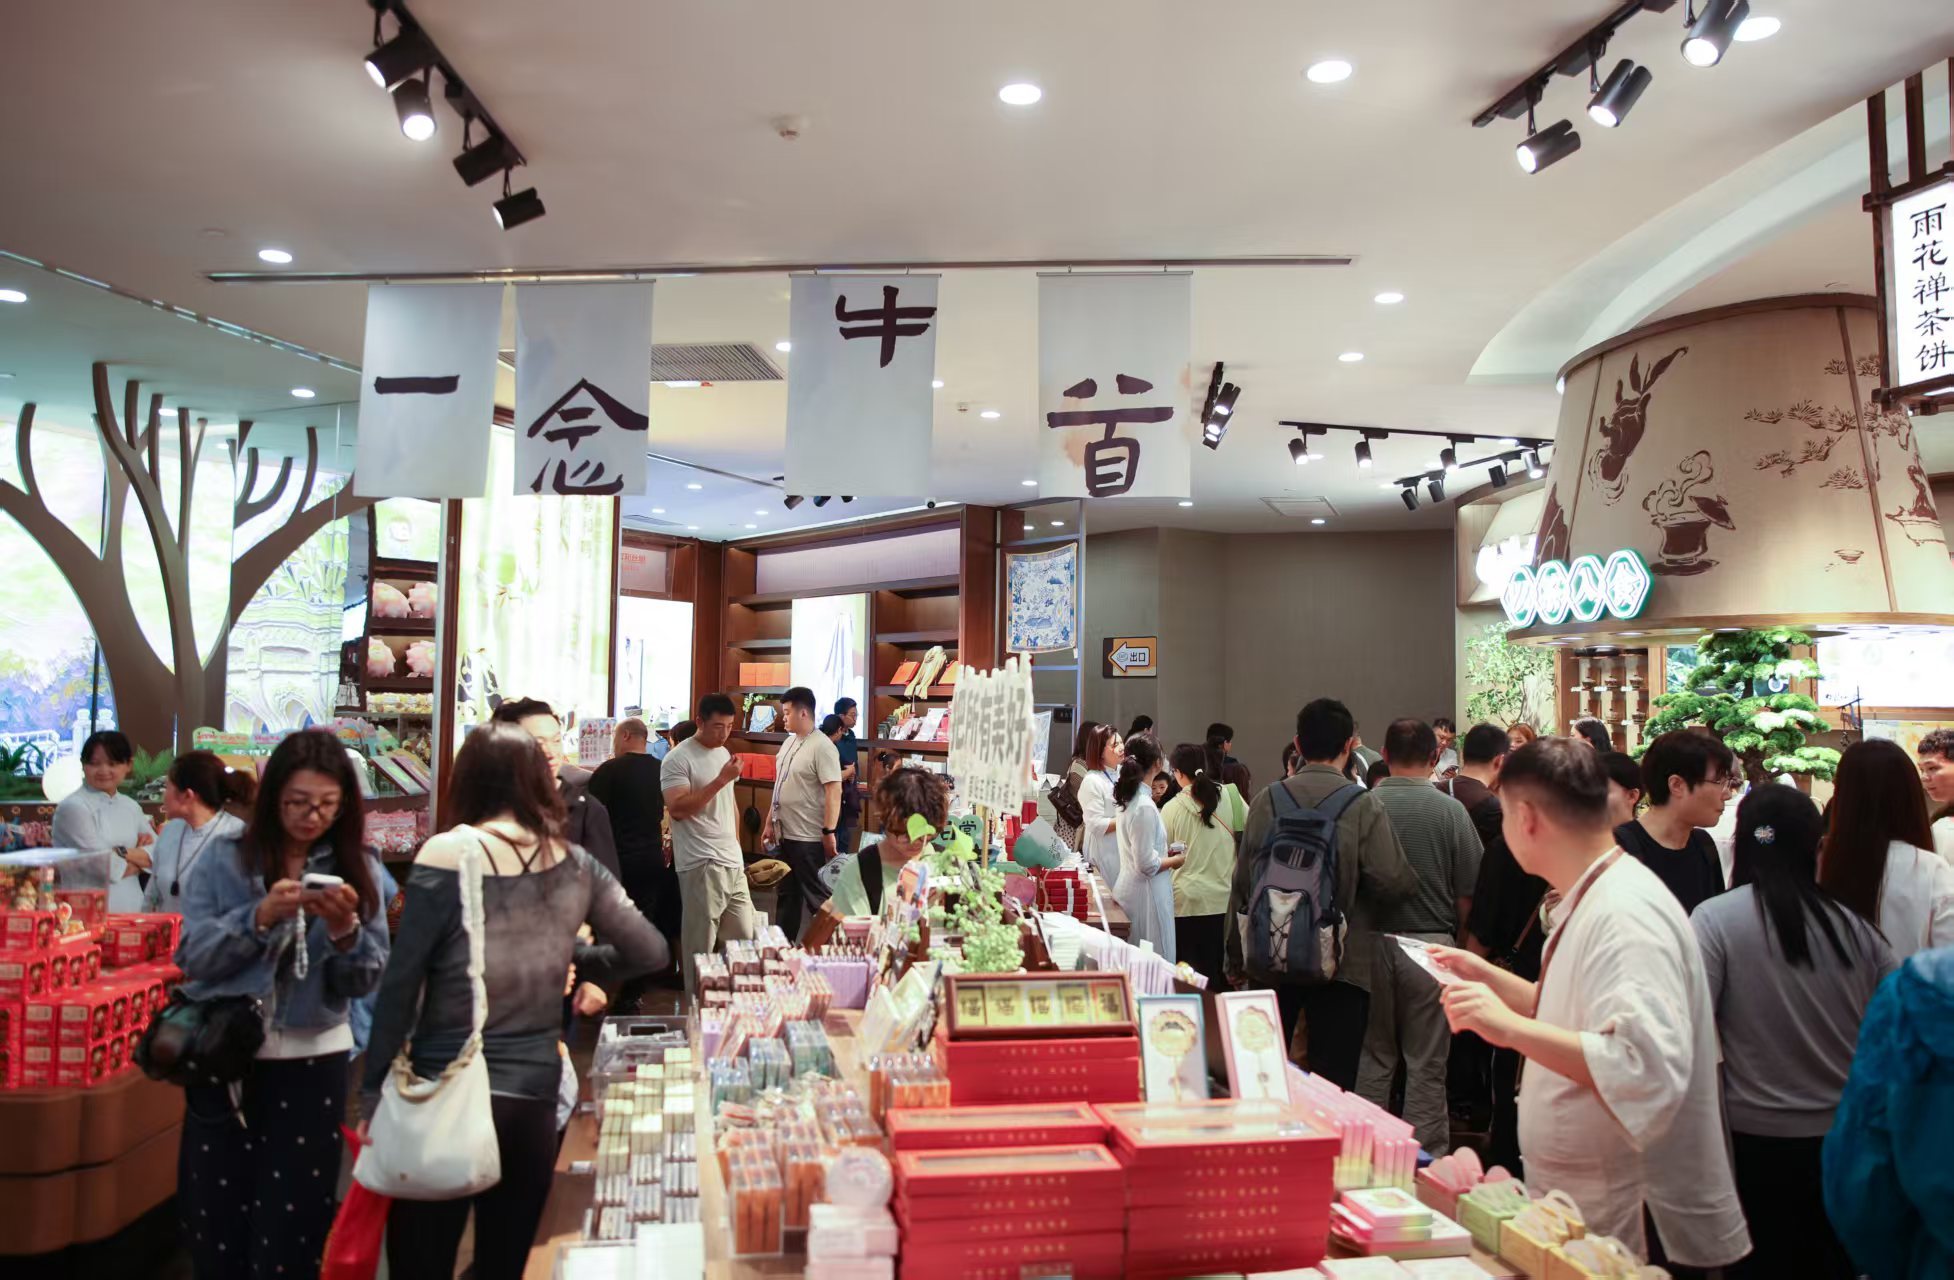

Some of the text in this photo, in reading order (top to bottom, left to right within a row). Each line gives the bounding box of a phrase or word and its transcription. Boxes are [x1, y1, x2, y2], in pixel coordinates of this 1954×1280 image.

[1910, 203, 1953, 372] 雨花禅茶饼
[527, 378, 649, 495] 念
[836, 285, 937, 368] 牛
[1047, 374, 1174, 497] 首
[1129, 651, 1146, 663] 出口
[951, 684, 1027, 766] 把所有美好
